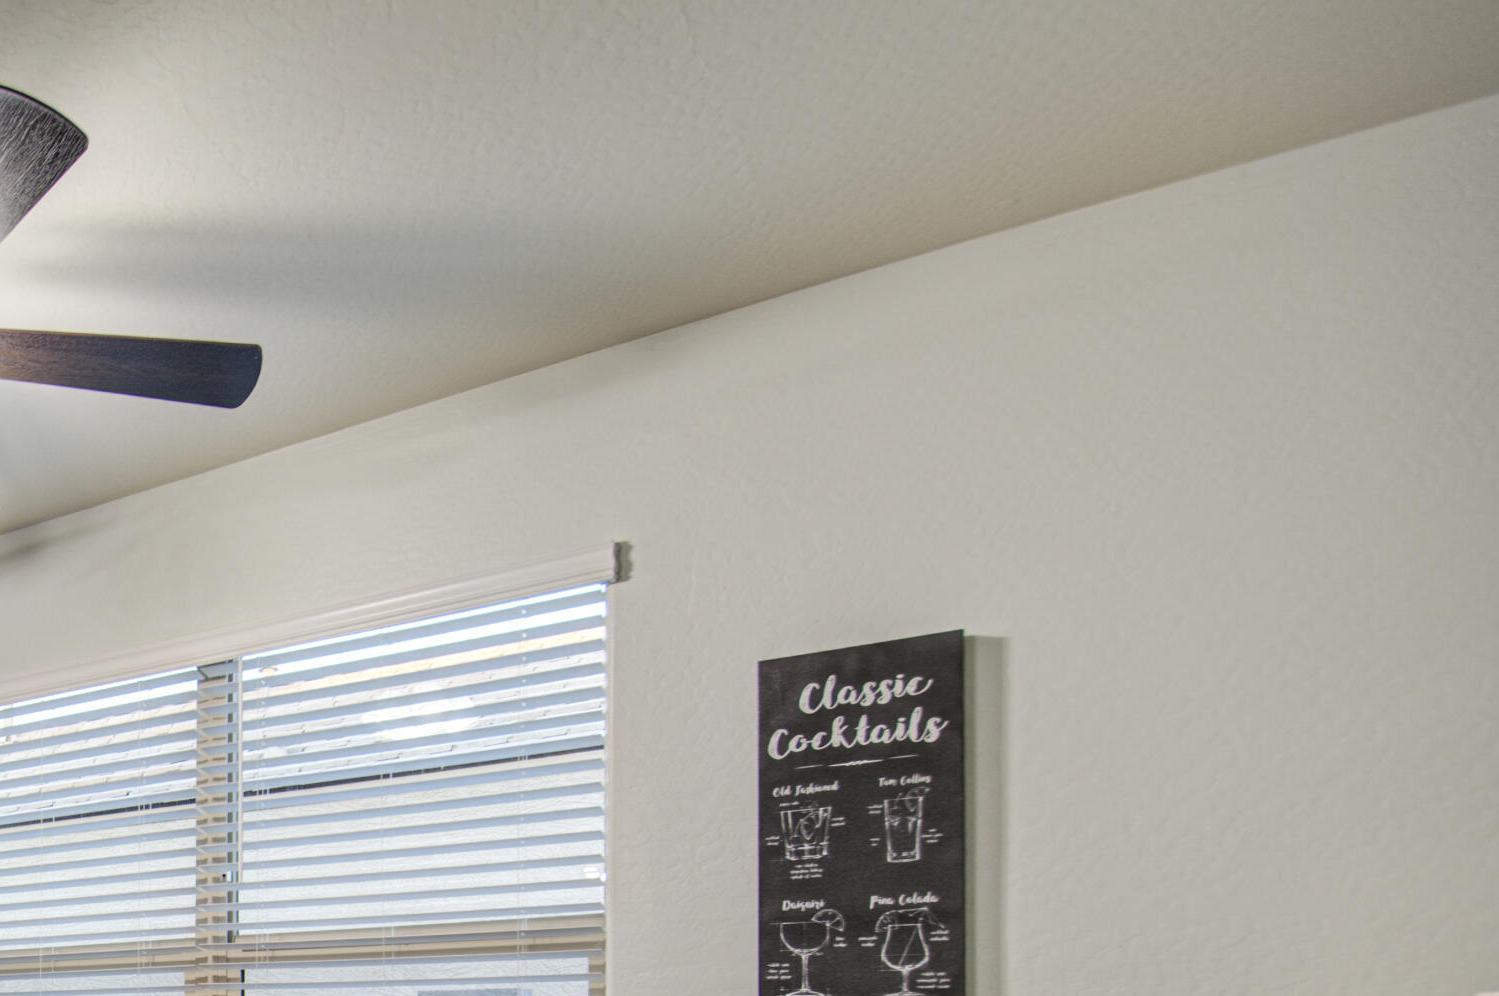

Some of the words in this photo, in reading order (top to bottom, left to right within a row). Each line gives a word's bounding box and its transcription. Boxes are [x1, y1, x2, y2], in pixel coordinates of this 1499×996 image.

[799, 673, 934, 714] Classic
[768, 706, 949, 760] Cocktails
[879, 776, 897, 787] Tom
[900, 773, 932, 786] Collins
[772, 786, 791, 798] Old
[794, 780, 840, 797] Fashioned
[781, 899, 826, 912] Daiquiri
[899, 891, 939, 905] Colada
